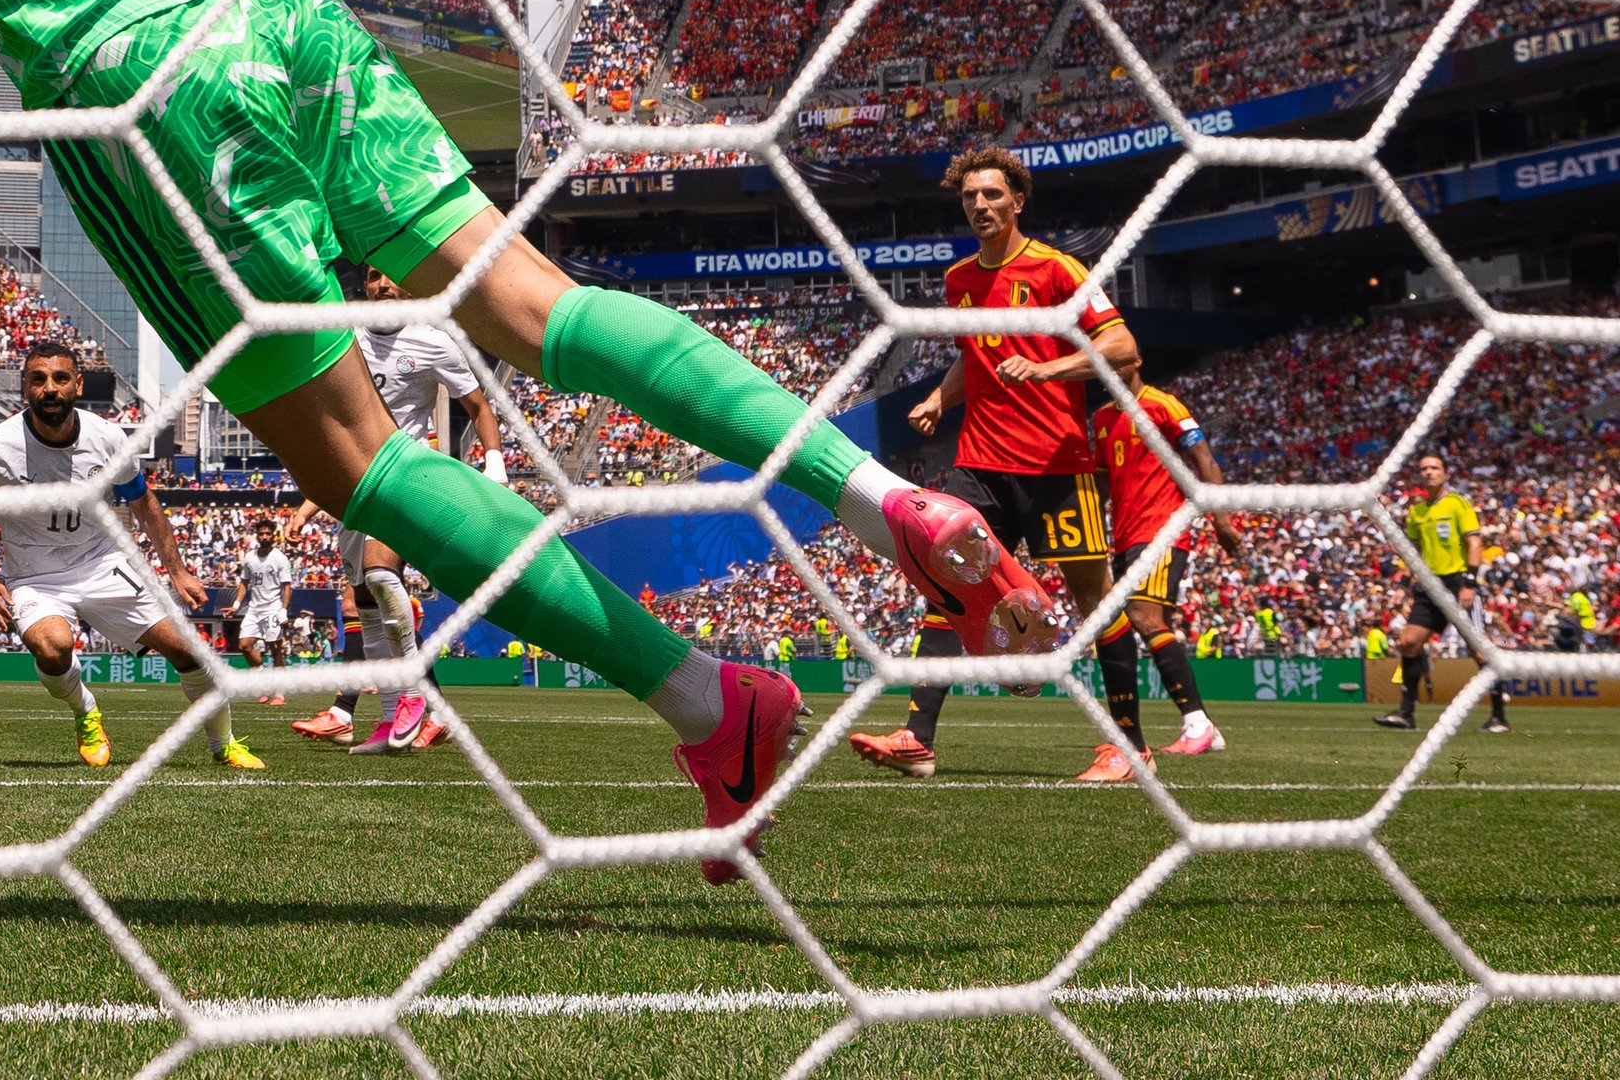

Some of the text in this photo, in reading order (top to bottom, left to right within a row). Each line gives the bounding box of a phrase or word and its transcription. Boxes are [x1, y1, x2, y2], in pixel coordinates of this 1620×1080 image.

[1513, 15, 1620, 63] SEATTLE
[1062, 134, 1131, 164] WORLD
[1133, 125, 1169, 151] CUP
[570, 174, 675, 197] SEATTLE
[695, 243, 955, 273] FIFA WORLD CP 2026
[1114, 439, 1125, 467] 8
[1042, 509, 1082, 550] 15
[113, 559, 145, 598] 1
[79, 655, 172, 684] 不能喝
[1279, 661, 1323, 701] 蒙牛
[1500, 671, 1598, 697] EATTLE
